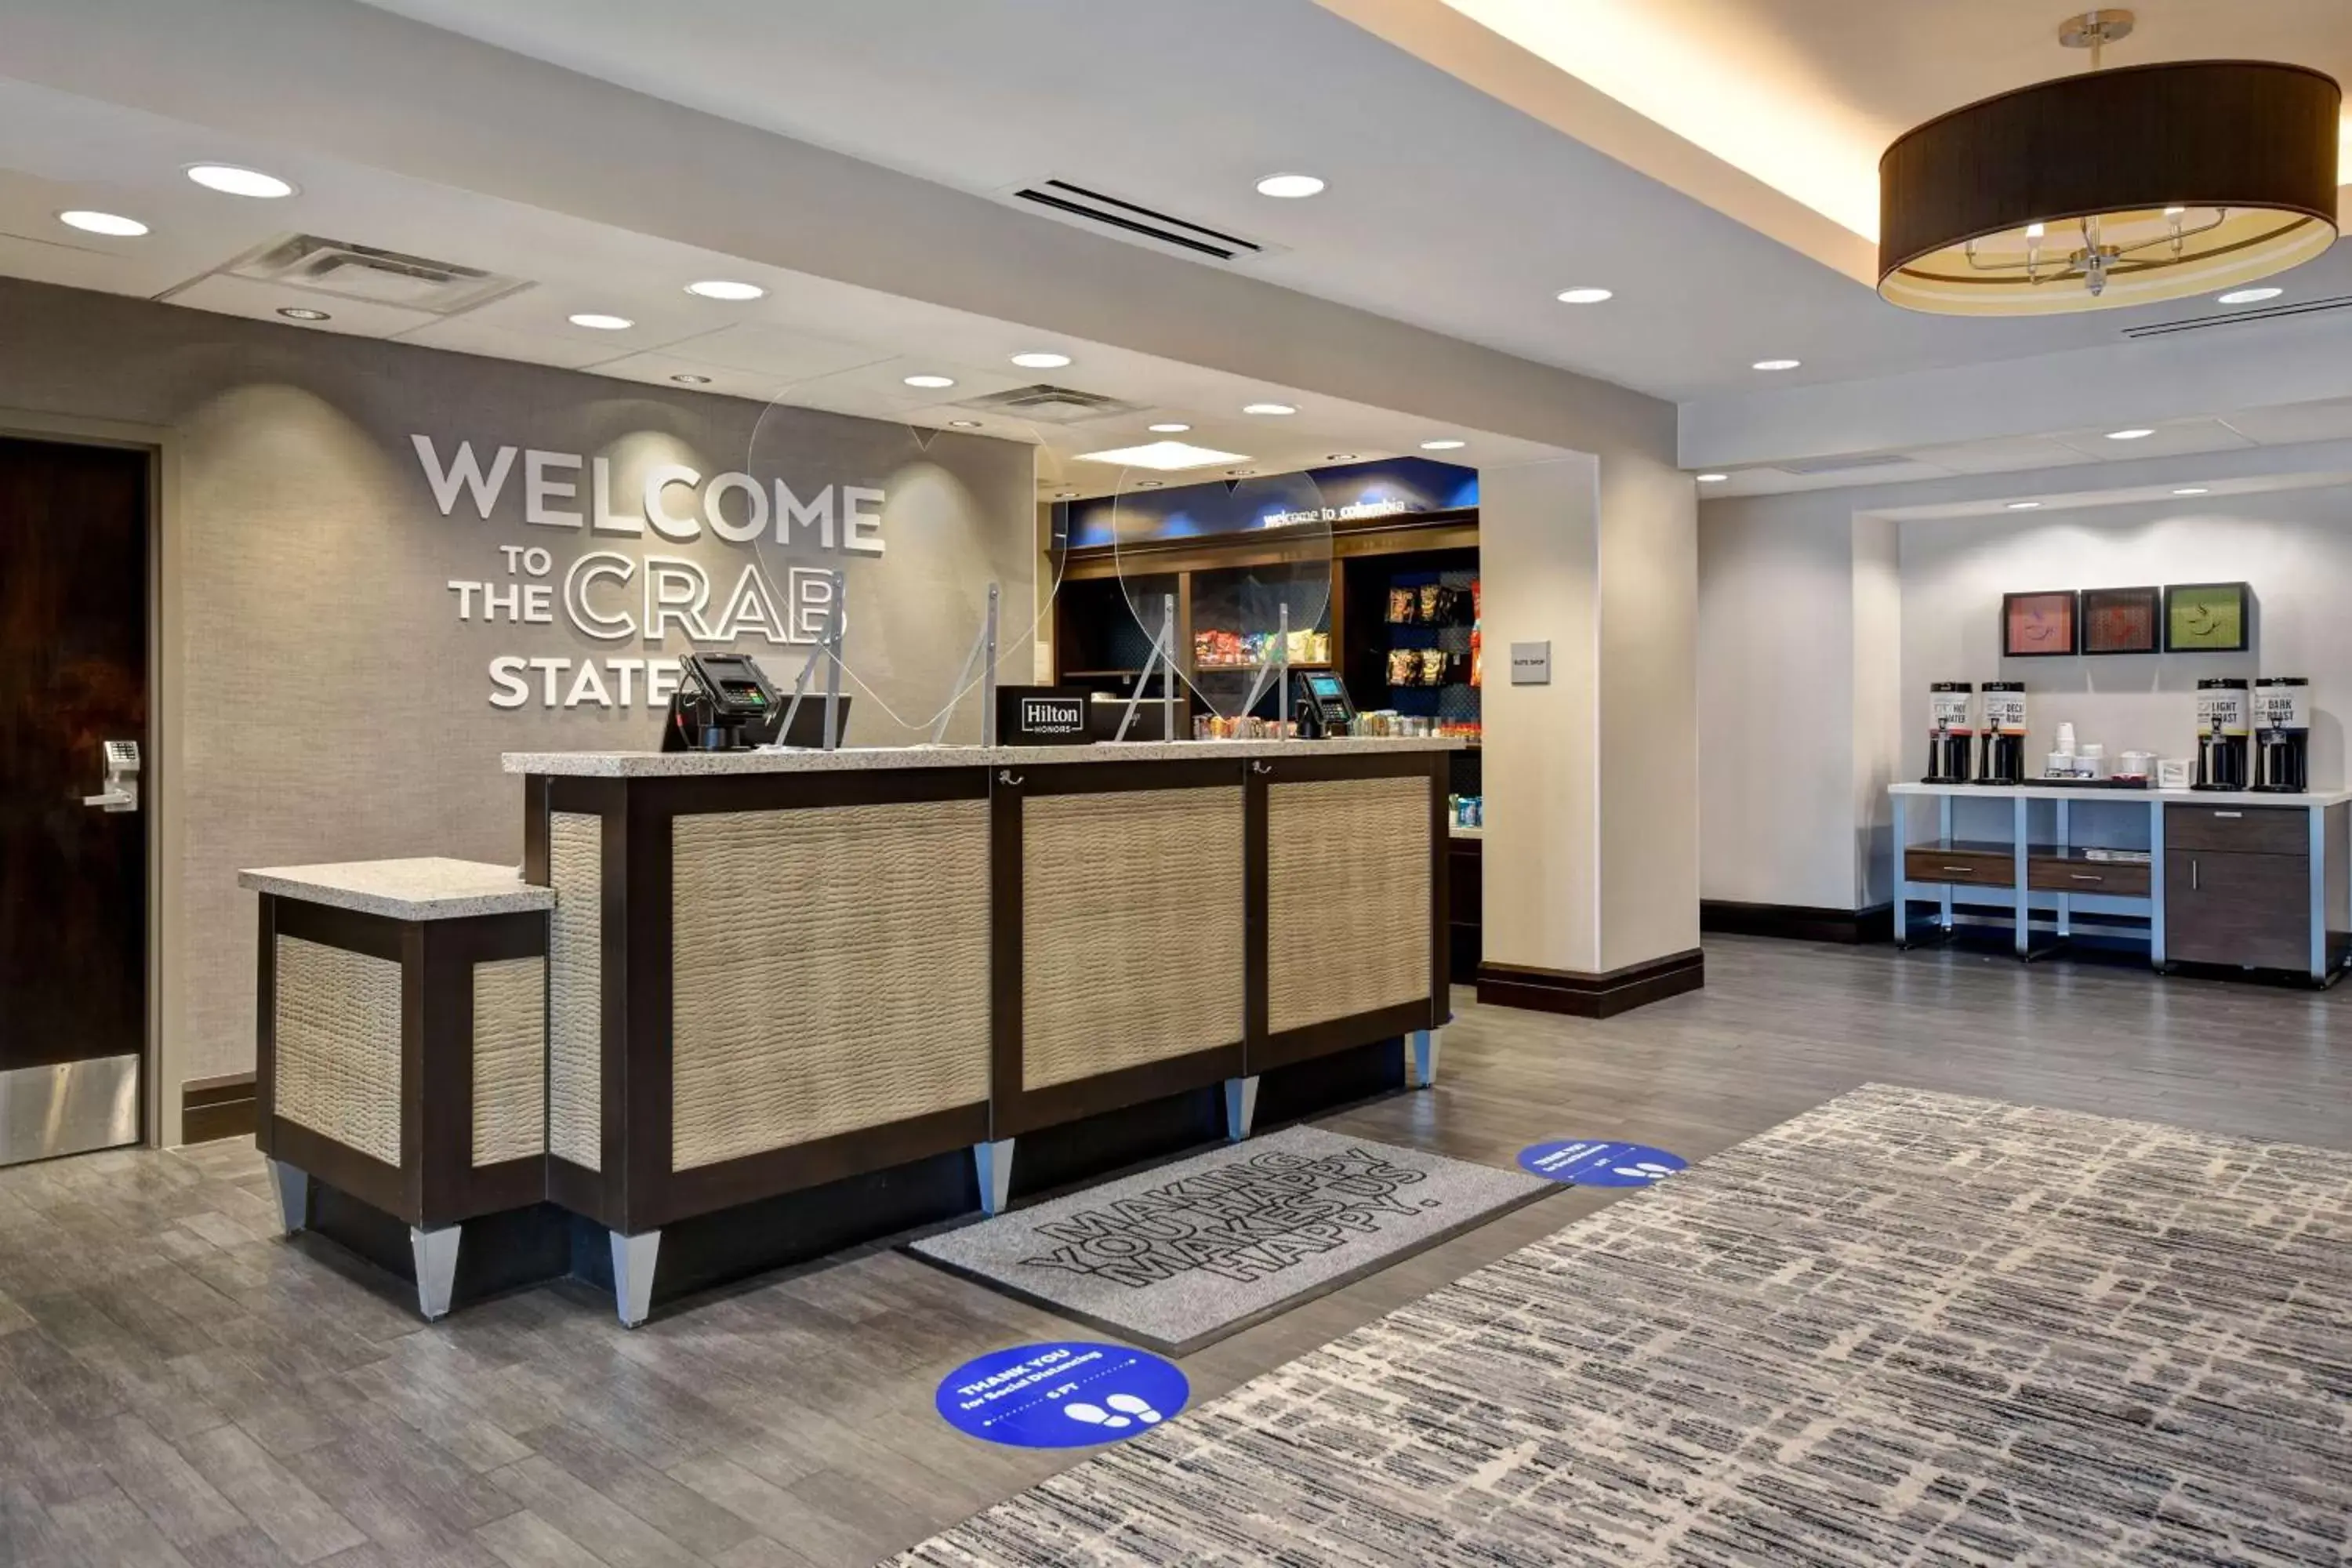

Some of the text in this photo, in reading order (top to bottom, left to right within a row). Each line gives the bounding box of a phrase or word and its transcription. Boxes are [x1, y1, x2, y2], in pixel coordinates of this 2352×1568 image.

[410, 434, 886, 554] WELCOME
[1264, 498, 1405, 528] welcome to columbia
[499, 545, 553, 576] TO
[448, 552, 848, 645] THE CRAB
[489, 656, 681, 707] STATE
[2268, 699, 2292, 710] DARK
[1028, 705, 1079, 723] Hilton
[1033, 724, 1072, 734] HONORS
[2212, 702, 2237, 712] LIGHT
[1018, 1147, 1395, 1275] YOU HAPPY
[1033, 1150, 1319, 1244] MAKING
[1093, 1164, 1428, 1287] MAKES US
[1193, 1194, 1442, 1283] HAPPY.
[957, 1348, 1072, 1396] THANK YOU
[960, 1350, 1104, 1410] for Social Distancing
[1046, 1381, 1080, 1399] 6 FT
